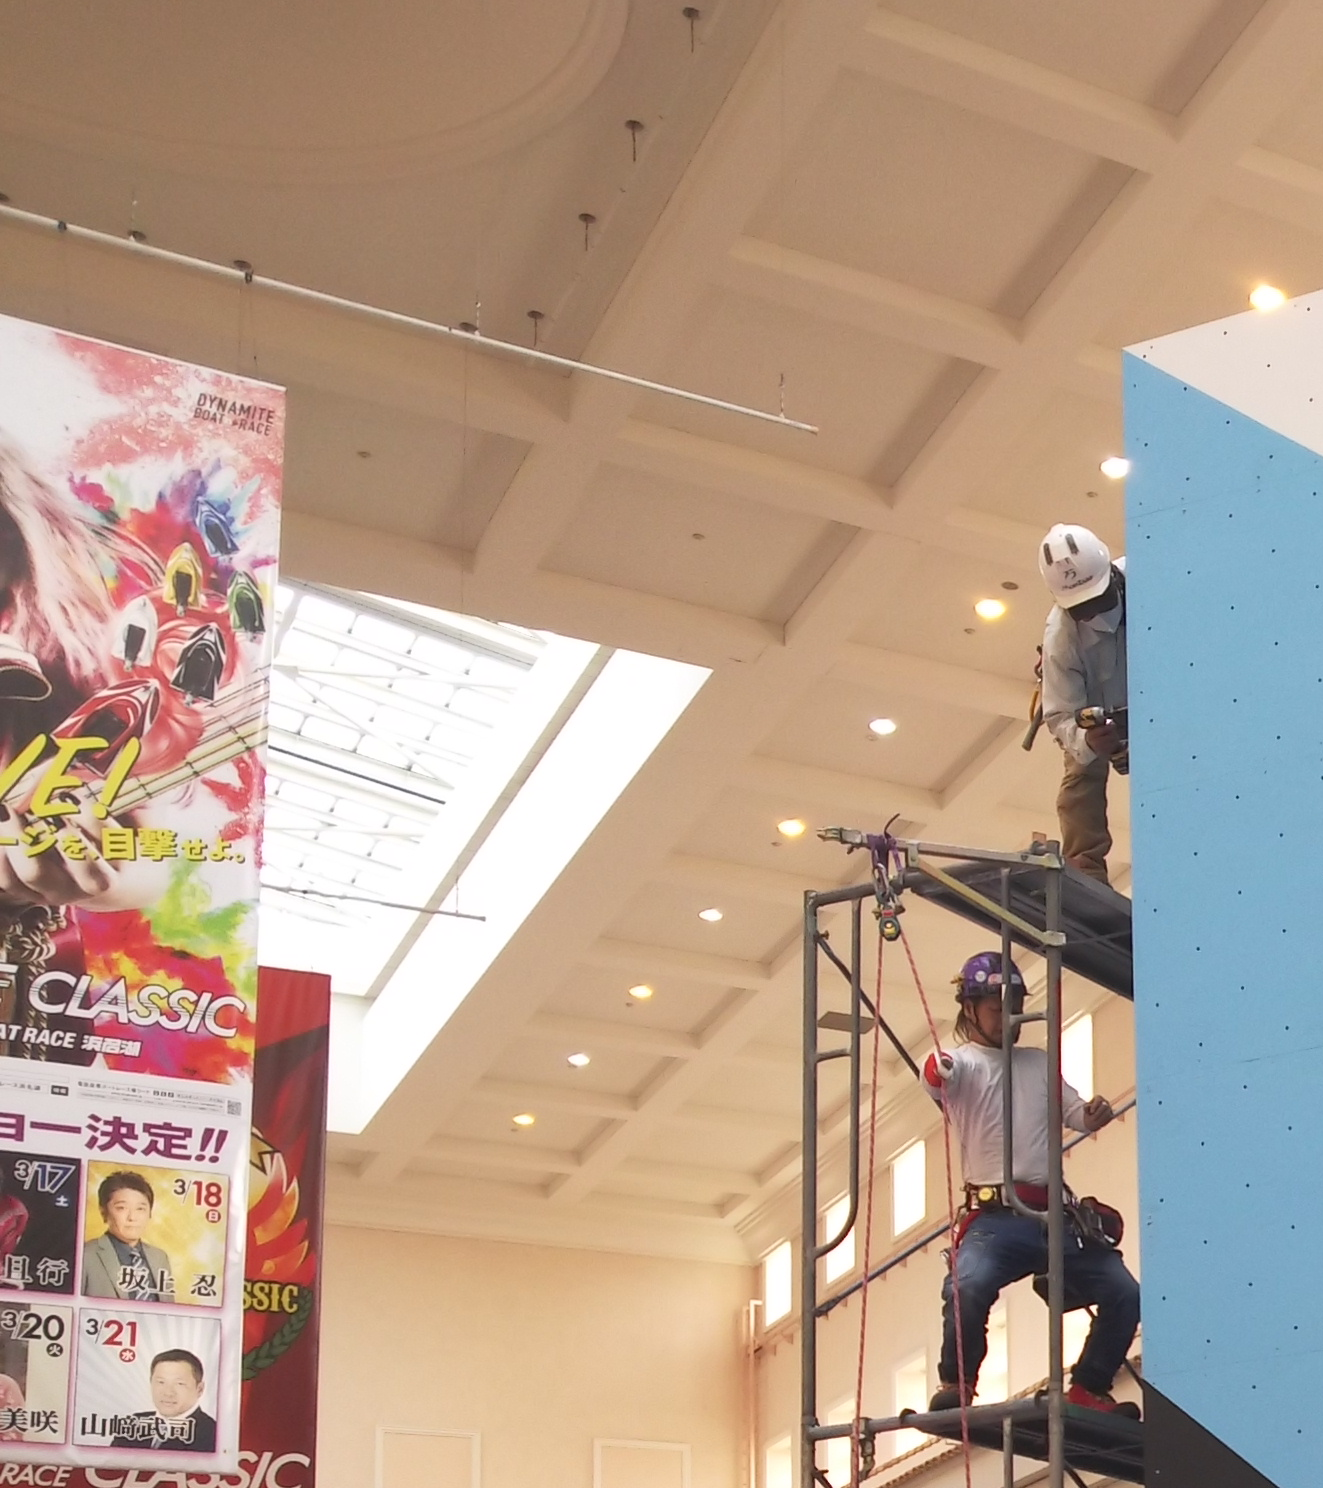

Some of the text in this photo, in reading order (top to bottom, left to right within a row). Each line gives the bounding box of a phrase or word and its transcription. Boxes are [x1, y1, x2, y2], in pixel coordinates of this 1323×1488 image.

[194, 407, 272, 436] BOAT RACE
[197, 393, 275, 424] DYNAMITE
[28, 971, 246, 1038] CLASSIC
[22, 1027, 77, 1049] RACE
[81, 1034, 142, 1057] 浜名湖
[14, 1160, 76, 1194] 3/17
[55, 1196, 69, 1208] 土
[173, 1178, 223, 1208] 3/18
[1, 1311, 65, 1341] 3/20
[85, 1317, 138, 1347] 3/21
[46, 1342, 64, 1358] 火
[119, 1348, 136, 1363] 水
[0, 1408, 59, 1435] 美咲
[0, 1463, 73, 1488] RACE
